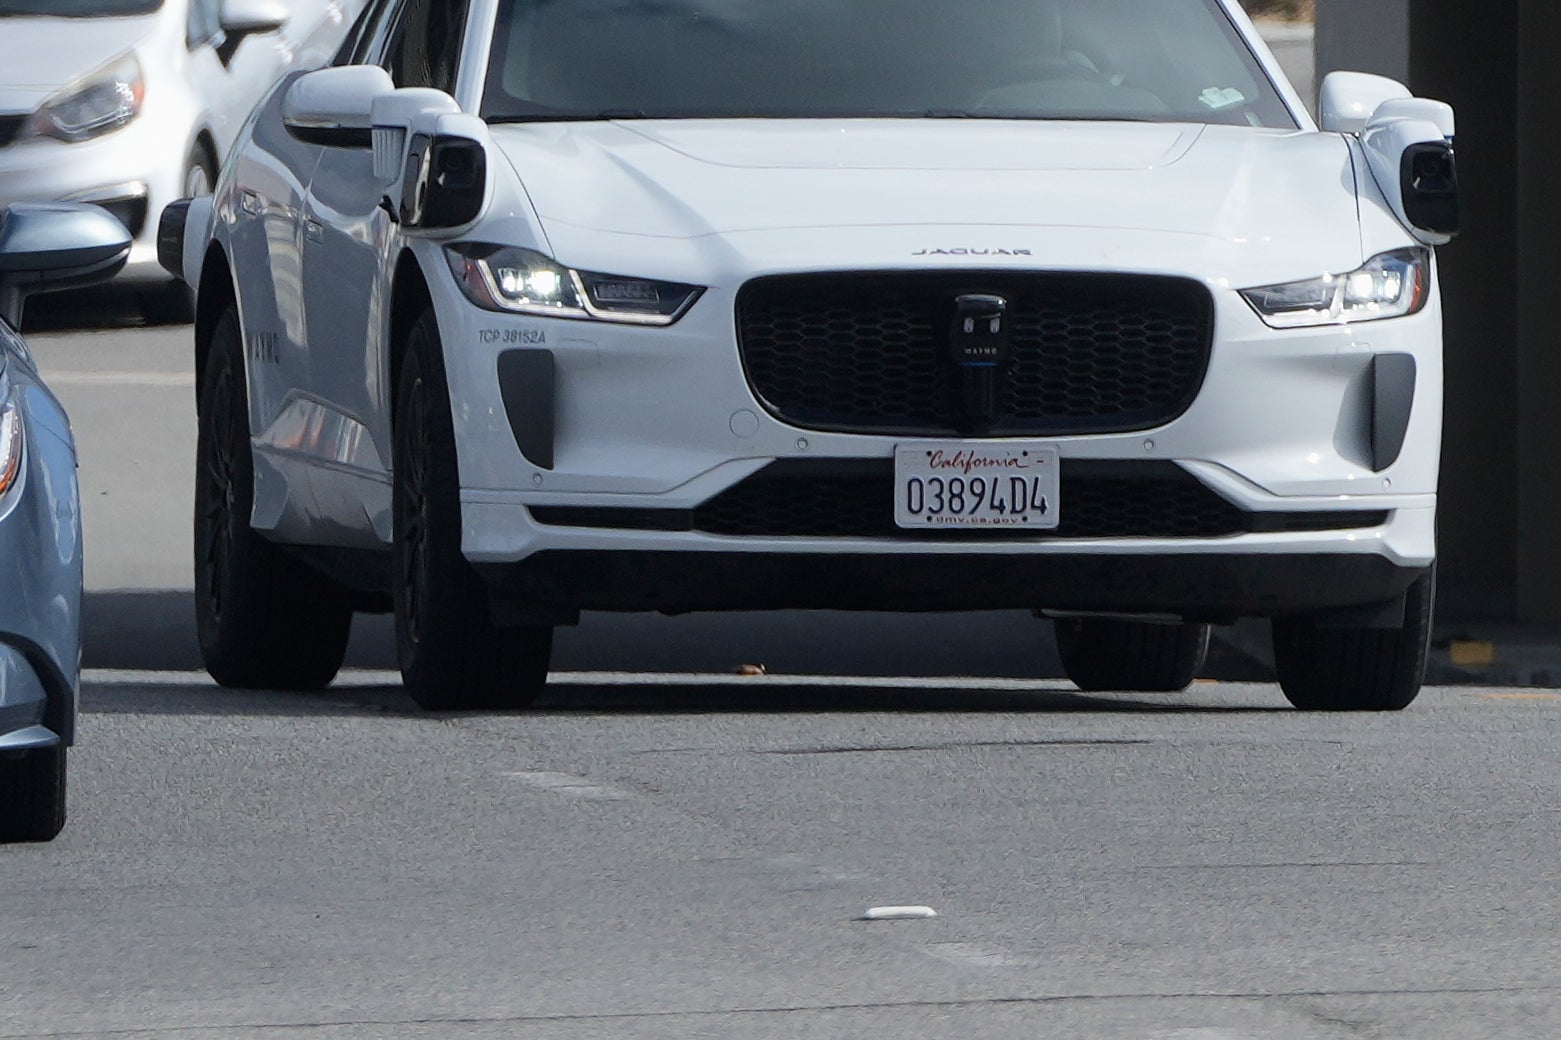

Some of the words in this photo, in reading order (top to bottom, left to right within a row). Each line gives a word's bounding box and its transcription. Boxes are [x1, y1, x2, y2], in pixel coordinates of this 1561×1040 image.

[911, 247, 1032, 256] JAGUAR
[479, 328, 500, 343] TCP
[929, 450, 1029, 474] California
[907, 477, 1048, 516] 03894D4
[936, 516, 1019, 525] dmv.ca.gov
